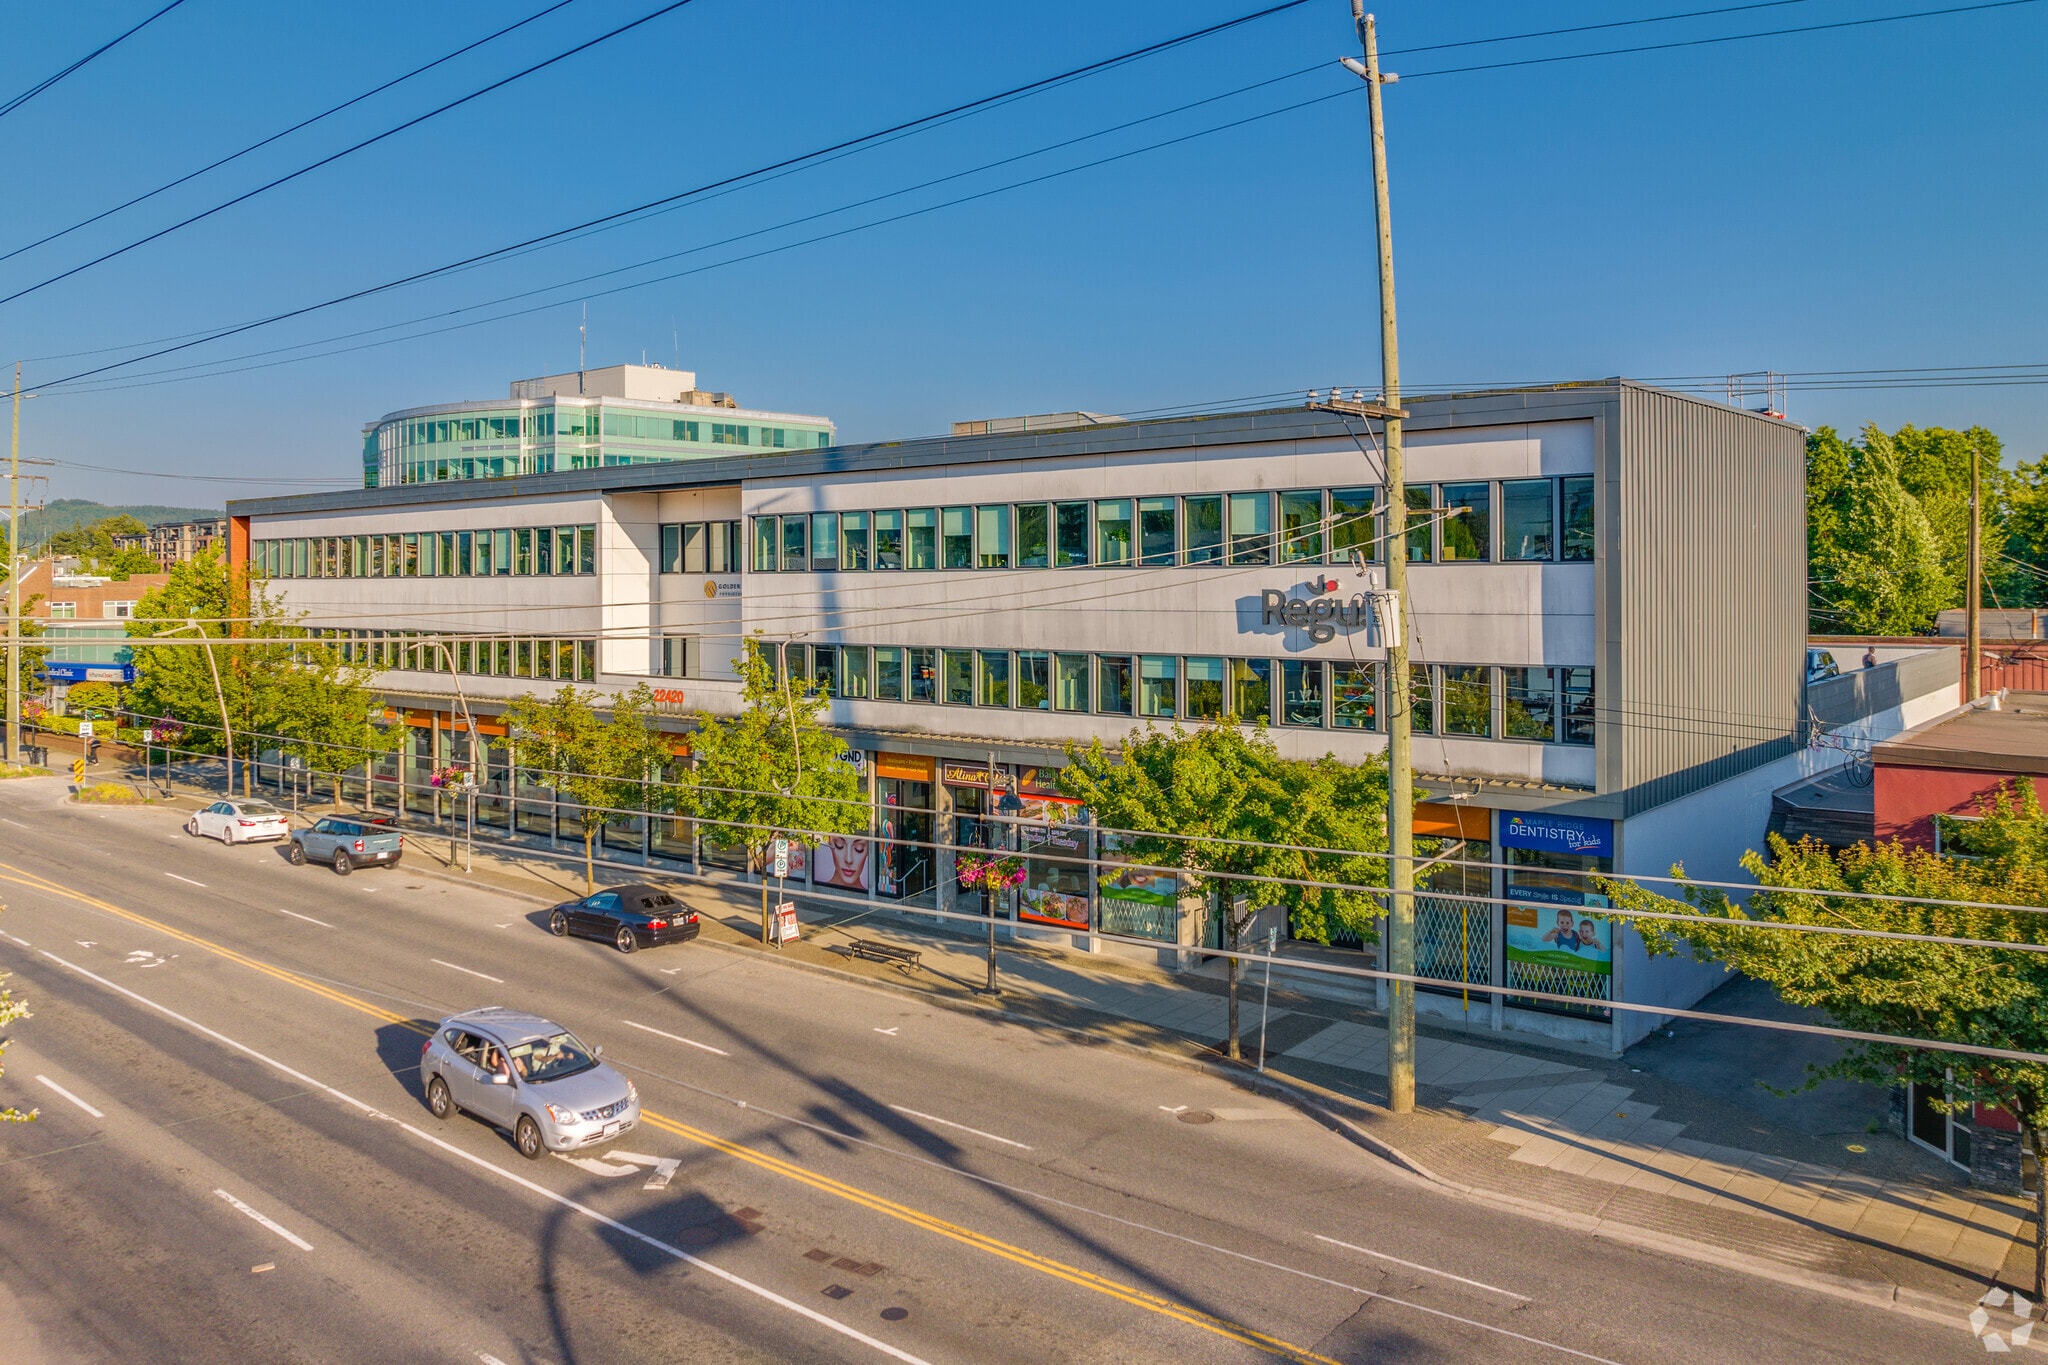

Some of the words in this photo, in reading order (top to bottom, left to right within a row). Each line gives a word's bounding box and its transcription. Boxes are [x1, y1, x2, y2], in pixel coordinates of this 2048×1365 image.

[653, 689, 684, 703] 22420
[840, 750, 862, 763] GND
[1525, 818, 1554, 828] MAPLE
[1557, 821, 1585, 831] RIDGE
[1509, 824, 1585, 841] DENTISTRY
[1568, 837, 1582, 849] for
[1582, 834, 1602, 847] kids
[1510, 888, 1532, 898] EVERY
[1551, 894, 1559, 902] IS
